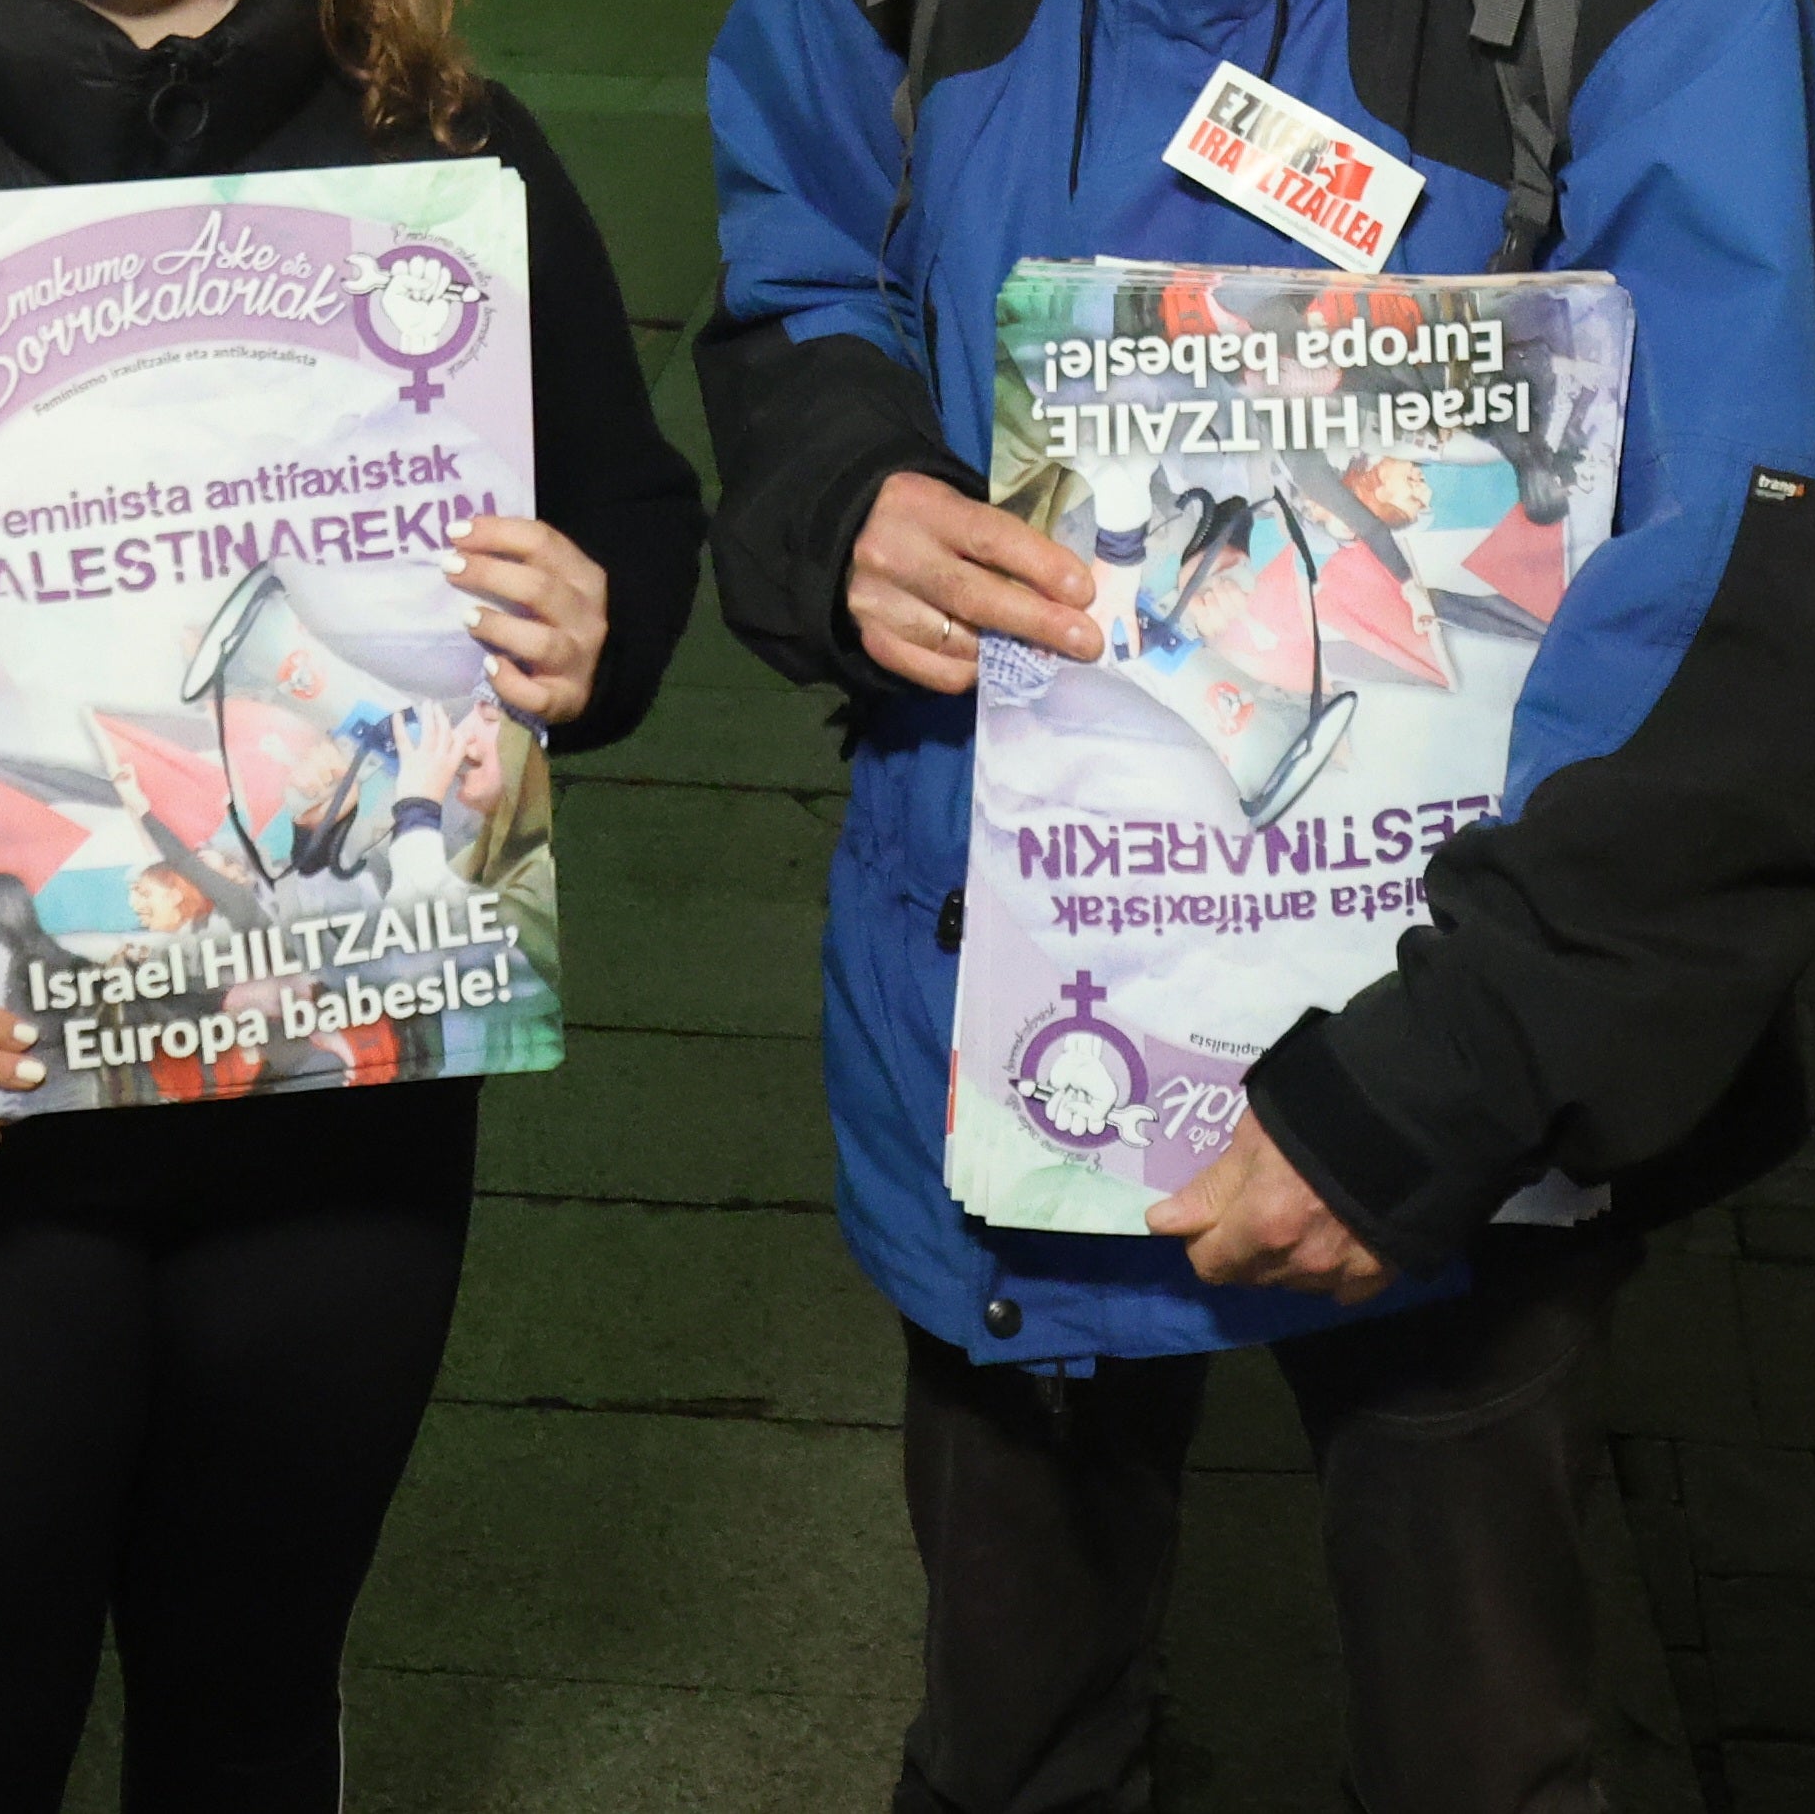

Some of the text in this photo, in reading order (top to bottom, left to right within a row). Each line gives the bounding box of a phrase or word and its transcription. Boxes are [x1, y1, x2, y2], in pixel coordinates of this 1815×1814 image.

[1206, 81, 1329, 175] EZKER
[153, 209, 281, 275] Aske
[280, 251, 314, 279] eta
[31, 345, 318, 418] Feminismo iraultzaile eta antikapitalista
[1043, 318, 1504, 392] Europa babesle!
[1031, 381, 1530, 459] Israel HILTZAILE,
[205, 444, 461, 508] antifaxistak
[1051, 890, 1315, 936] antifaxistak
[28, 892, 520, 1012] Israel HILTZAILE,
[63, 953, 511, 1071] Europa babesle!
[1189, 1124, 1221, 1155] eta
